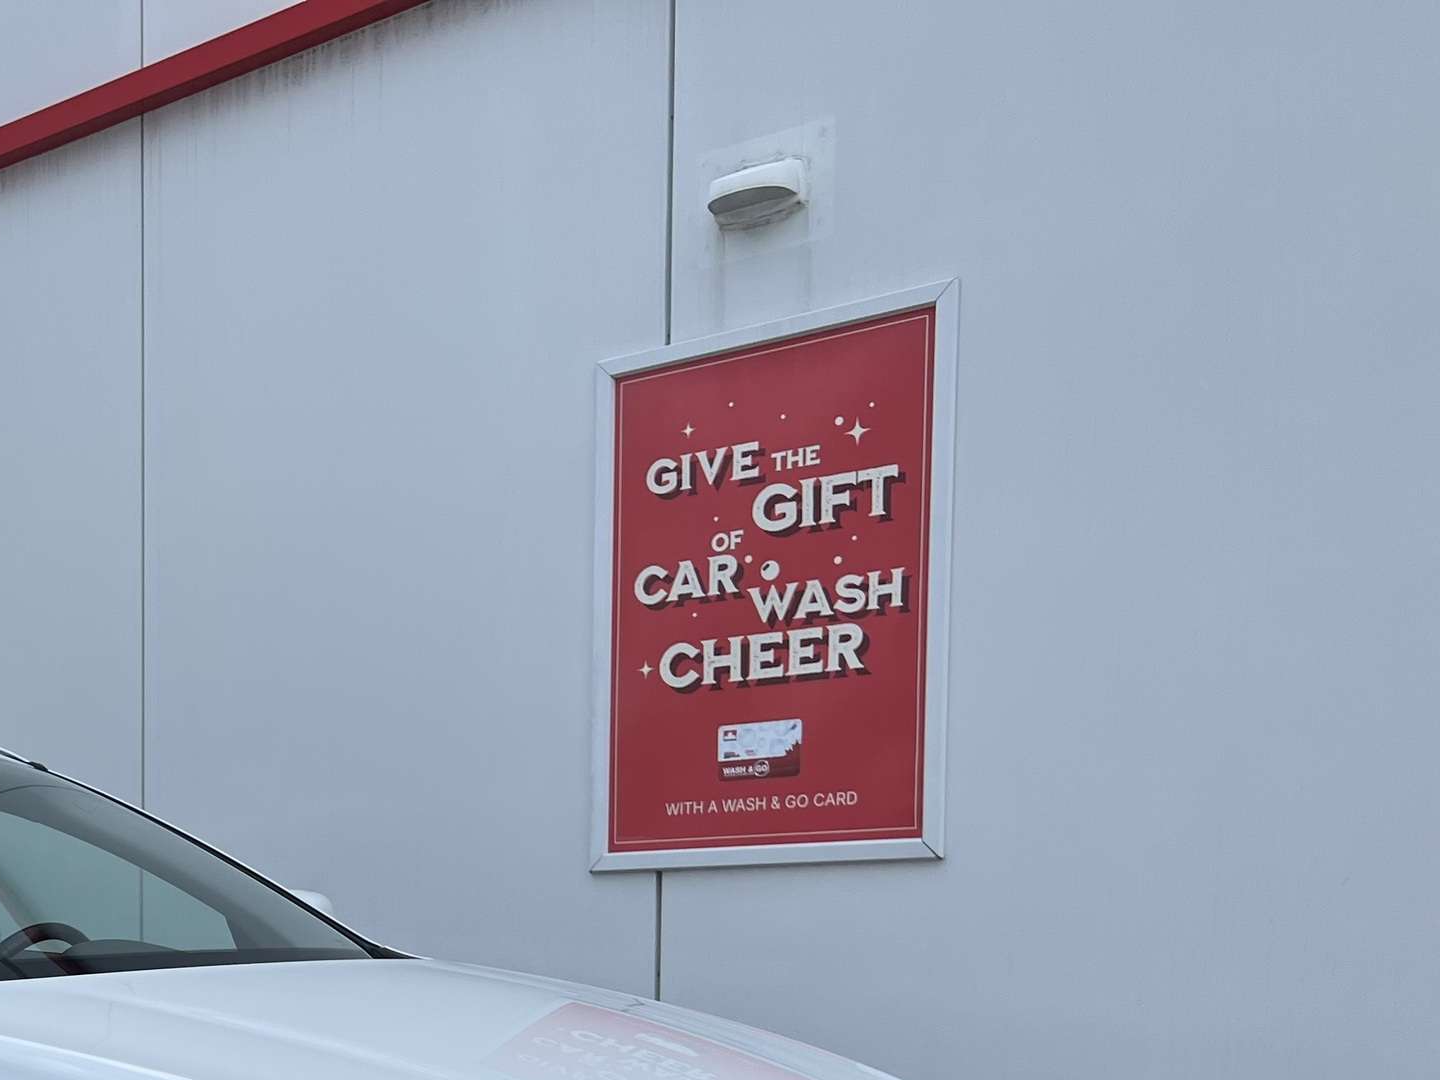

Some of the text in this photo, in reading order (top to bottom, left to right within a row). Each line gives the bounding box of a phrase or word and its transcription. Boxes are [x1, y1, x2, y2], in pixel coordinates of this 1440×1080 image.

[645, 441, 821, 495] GIVE THE
[752, 464, 900, 532] GIFT
[711, 529, 744, 552] OF
[634, 554, 907, 624] CAR WASH
[659, 623, 865, 689] CHEER
[665, 791, 858, 816] WITH A WASH & GO CARD
